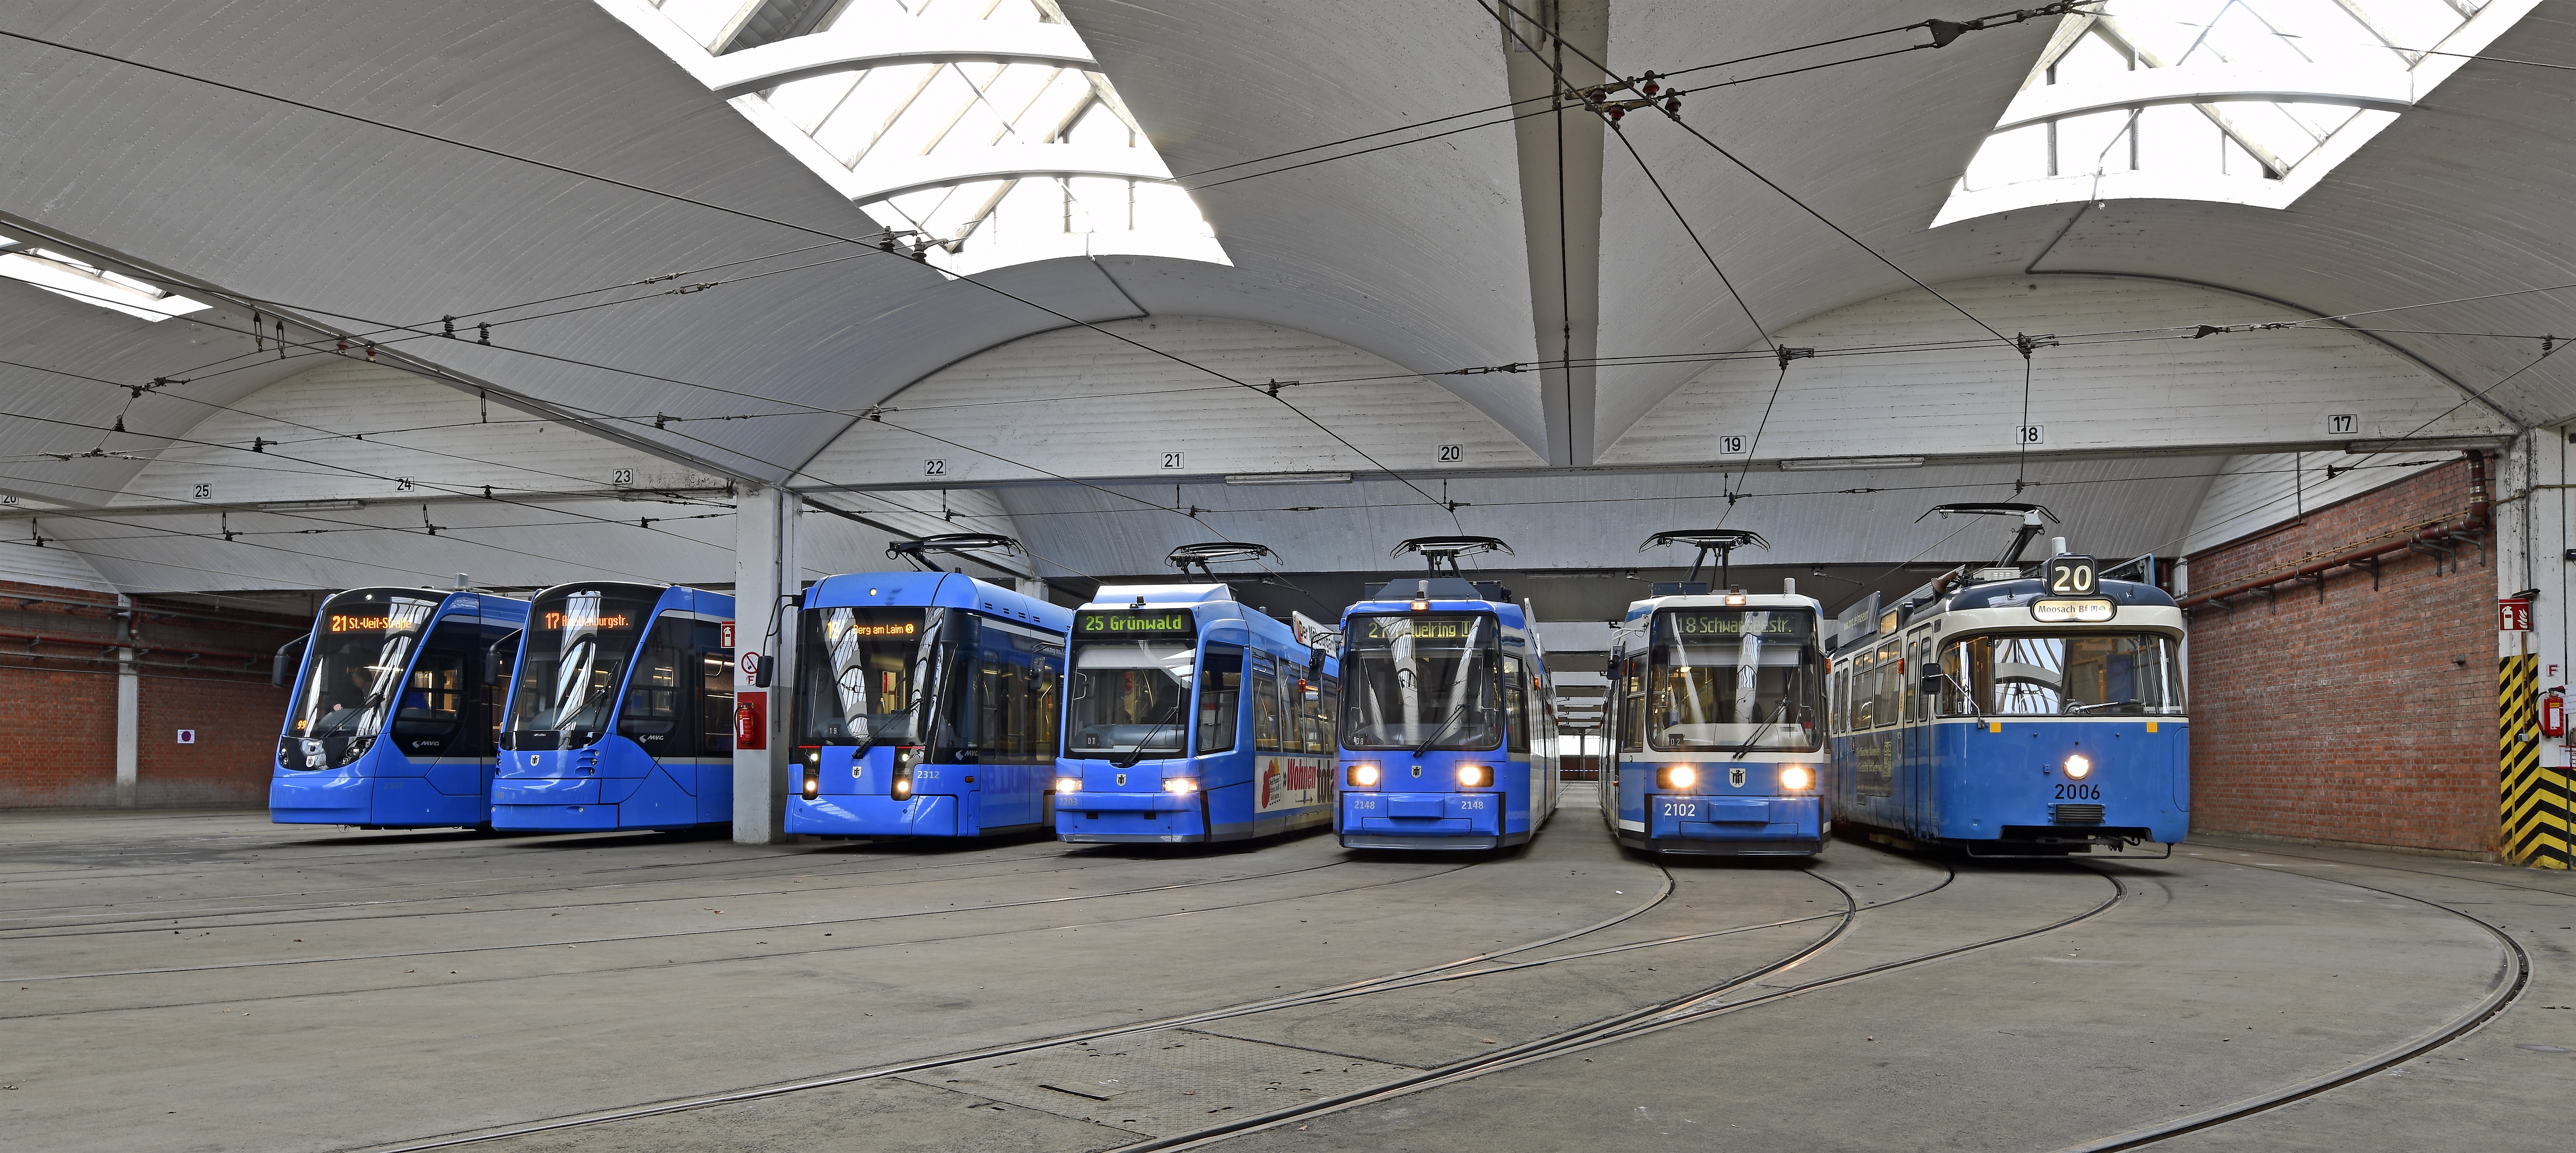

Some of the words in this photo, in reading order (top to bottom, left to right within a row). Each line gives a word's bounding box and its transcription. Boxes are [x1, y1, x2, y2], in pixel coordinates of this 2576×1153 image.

[2334, 415, 2351, 432] 17
[2021, 427, 2038, 442] 18
[1724, 437, 1741, 452] 19
[1440, 445, 1460, 461] 20
[1164, 453, 1180, 467] 21
[926, 461, 944, 474] 22
[615, 470, 630, 483] 23
[195, 485, 209, 497] 25
[397, 478, 411, 491] 24
[2053, 565, 2092, 591] 20
[2079, 605, 2088, 613] Bf
[332, 615, 347, 631] 21
[349, 617, 412, 631] St.-Veit-Straße
[545, 613, 560, 629] 17
[562, 614, 629, 628] Amalienburgstr.
[1086, 616, 1104, 631] 25
[1110, 615, 1182, 631] Grünwald
[1678, 617, 1696, 634] 18
[1699, 617, 1792, 634] Schwanseestr.
[853, 624, 871, 635] Berg
[873, 626, 885, 634] am
[886, 624, 903, 634] Laim
[1299, 620, 1308, 640] Der
[2549, 665, 2558, 676] F
[748, 676, 755, 684] F
[297, 720, 307, 729] 99
[917, 770, 940, 779] 2312
[1287, 758, 1317, 791] Wohnen
[2055, 784, 2100, 800] 2006
[1059, 798, 1078, 806] 2203
[1354, 801, 1375, 809] 2148
[1461, 801, 1484, 810] 2148
[1665, 803, 1695, 816] 2102
